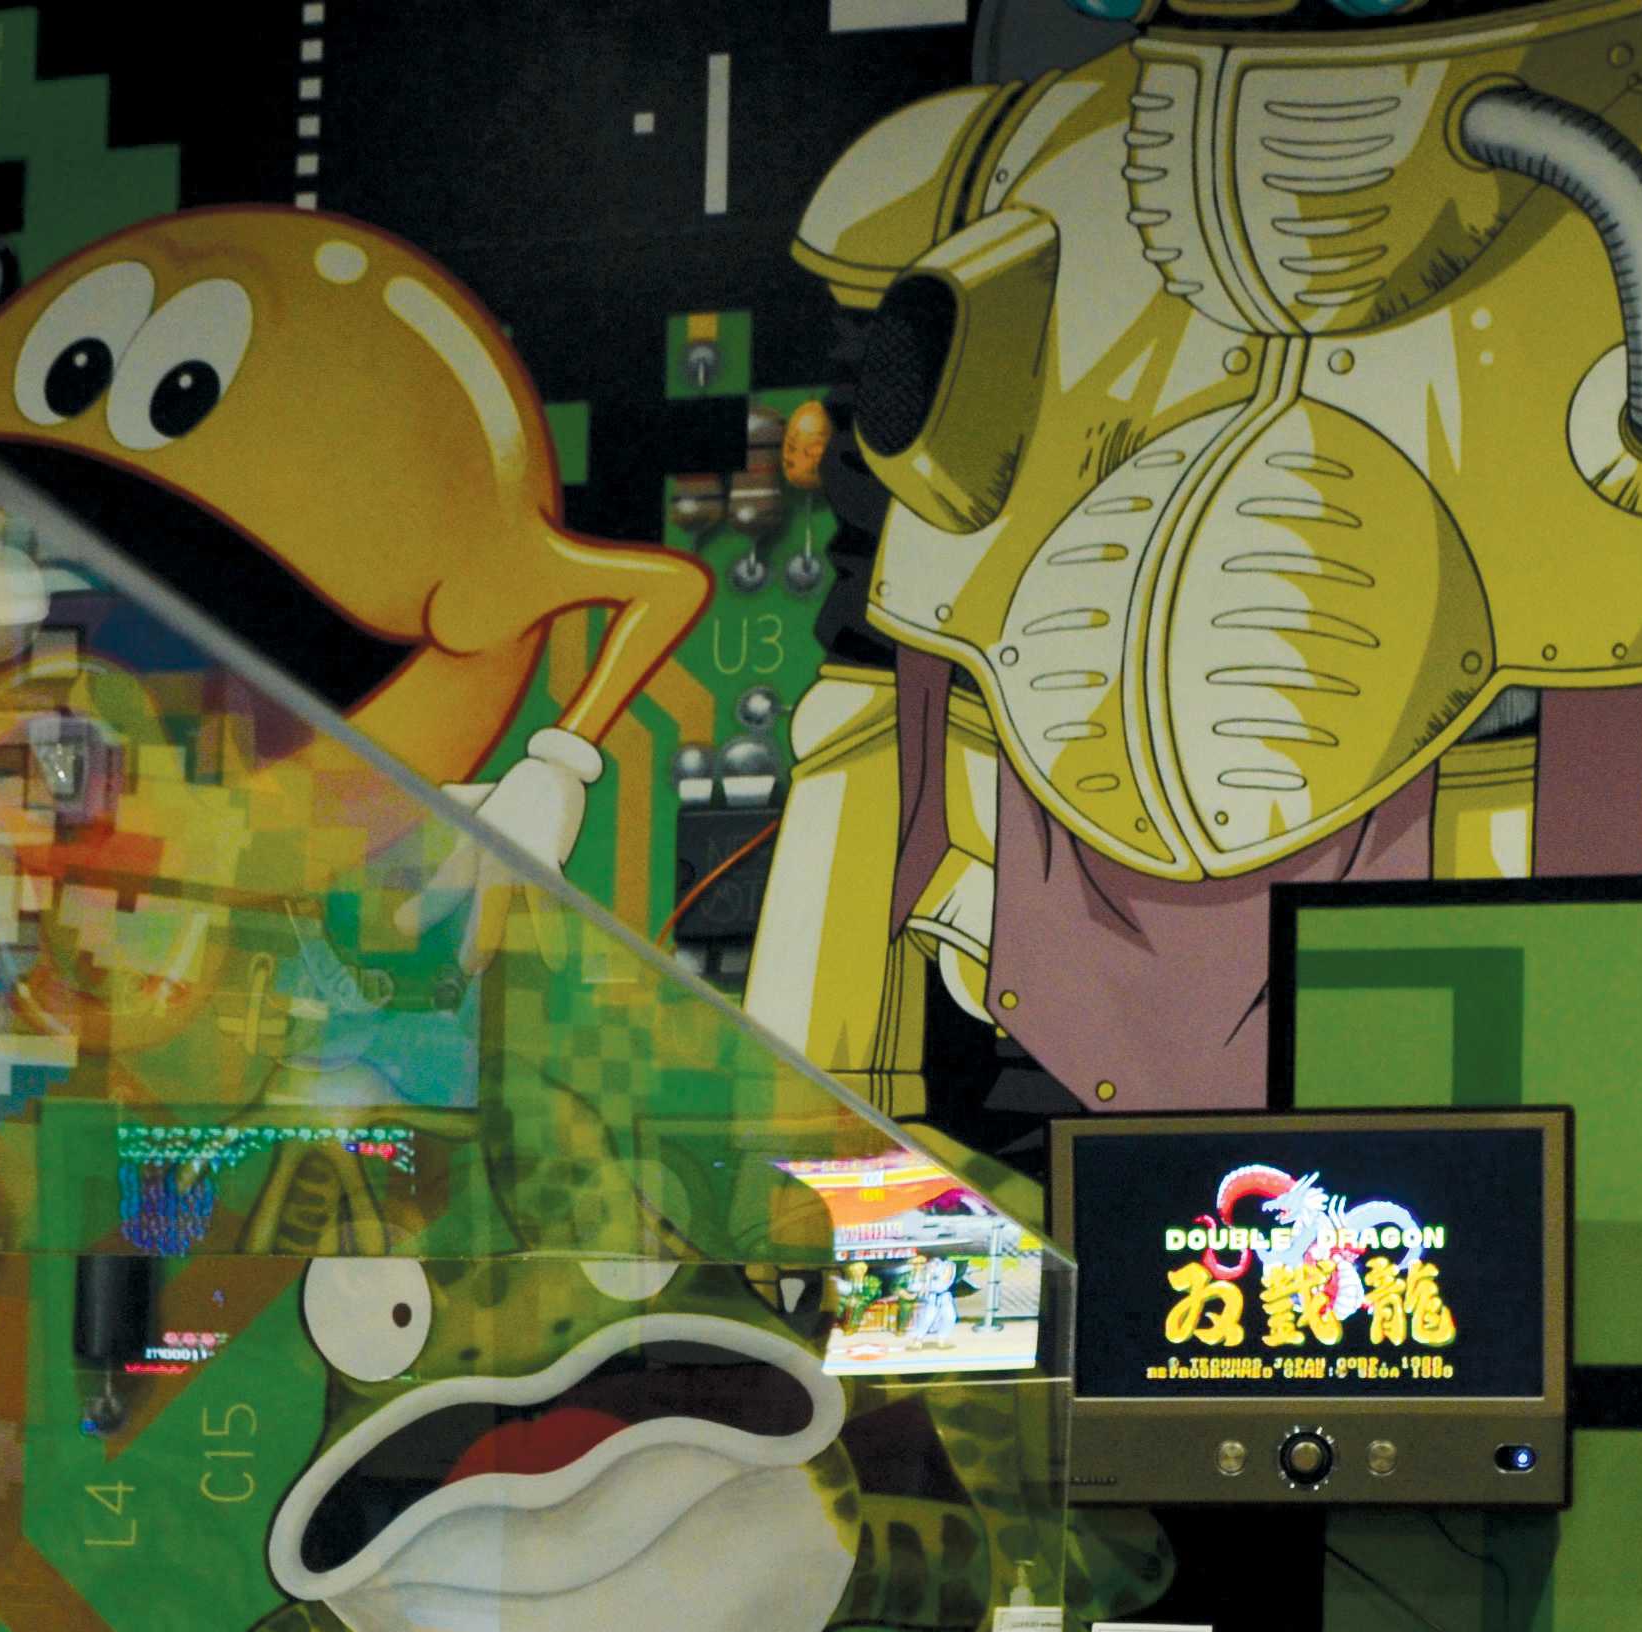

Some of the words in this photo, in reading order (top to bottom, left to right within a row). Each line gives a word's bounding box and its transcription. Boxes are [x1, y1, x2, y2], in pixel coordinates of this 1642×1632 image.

[711, 616, 785, 674] U3
[1165, 1227, 1291, 1251] DOUBLE
[1317, 1225, 1446, 1250] DRAGON
[200, 1403, 257, 1502] C15
[84, 1480, 137, 1546] L4
